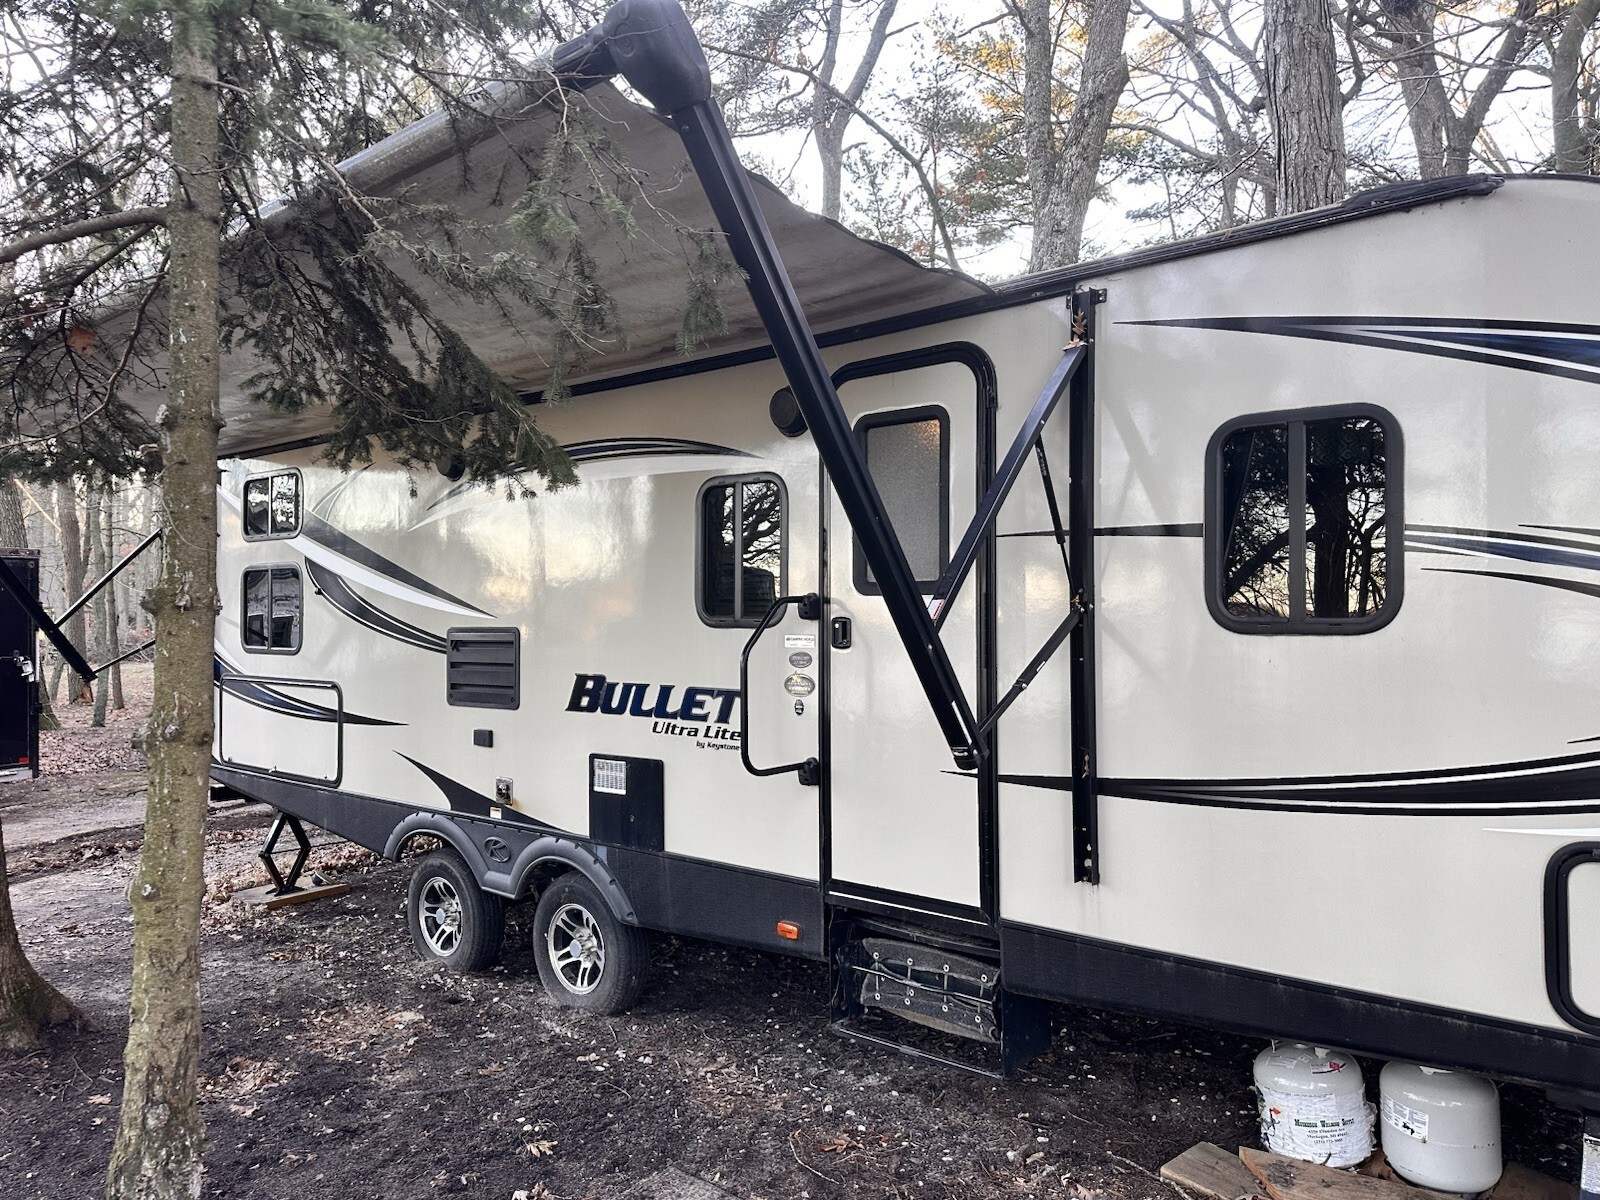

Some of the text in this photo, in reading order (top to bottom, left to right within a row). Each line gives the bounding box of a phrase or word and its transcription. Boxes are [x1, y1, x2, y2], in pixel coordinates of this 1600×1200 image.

[565, 673, 741, 724] BULLET
[652, 721, 741, 742] Ultra Lite
[696, 740, 740, 751] by Keystone
